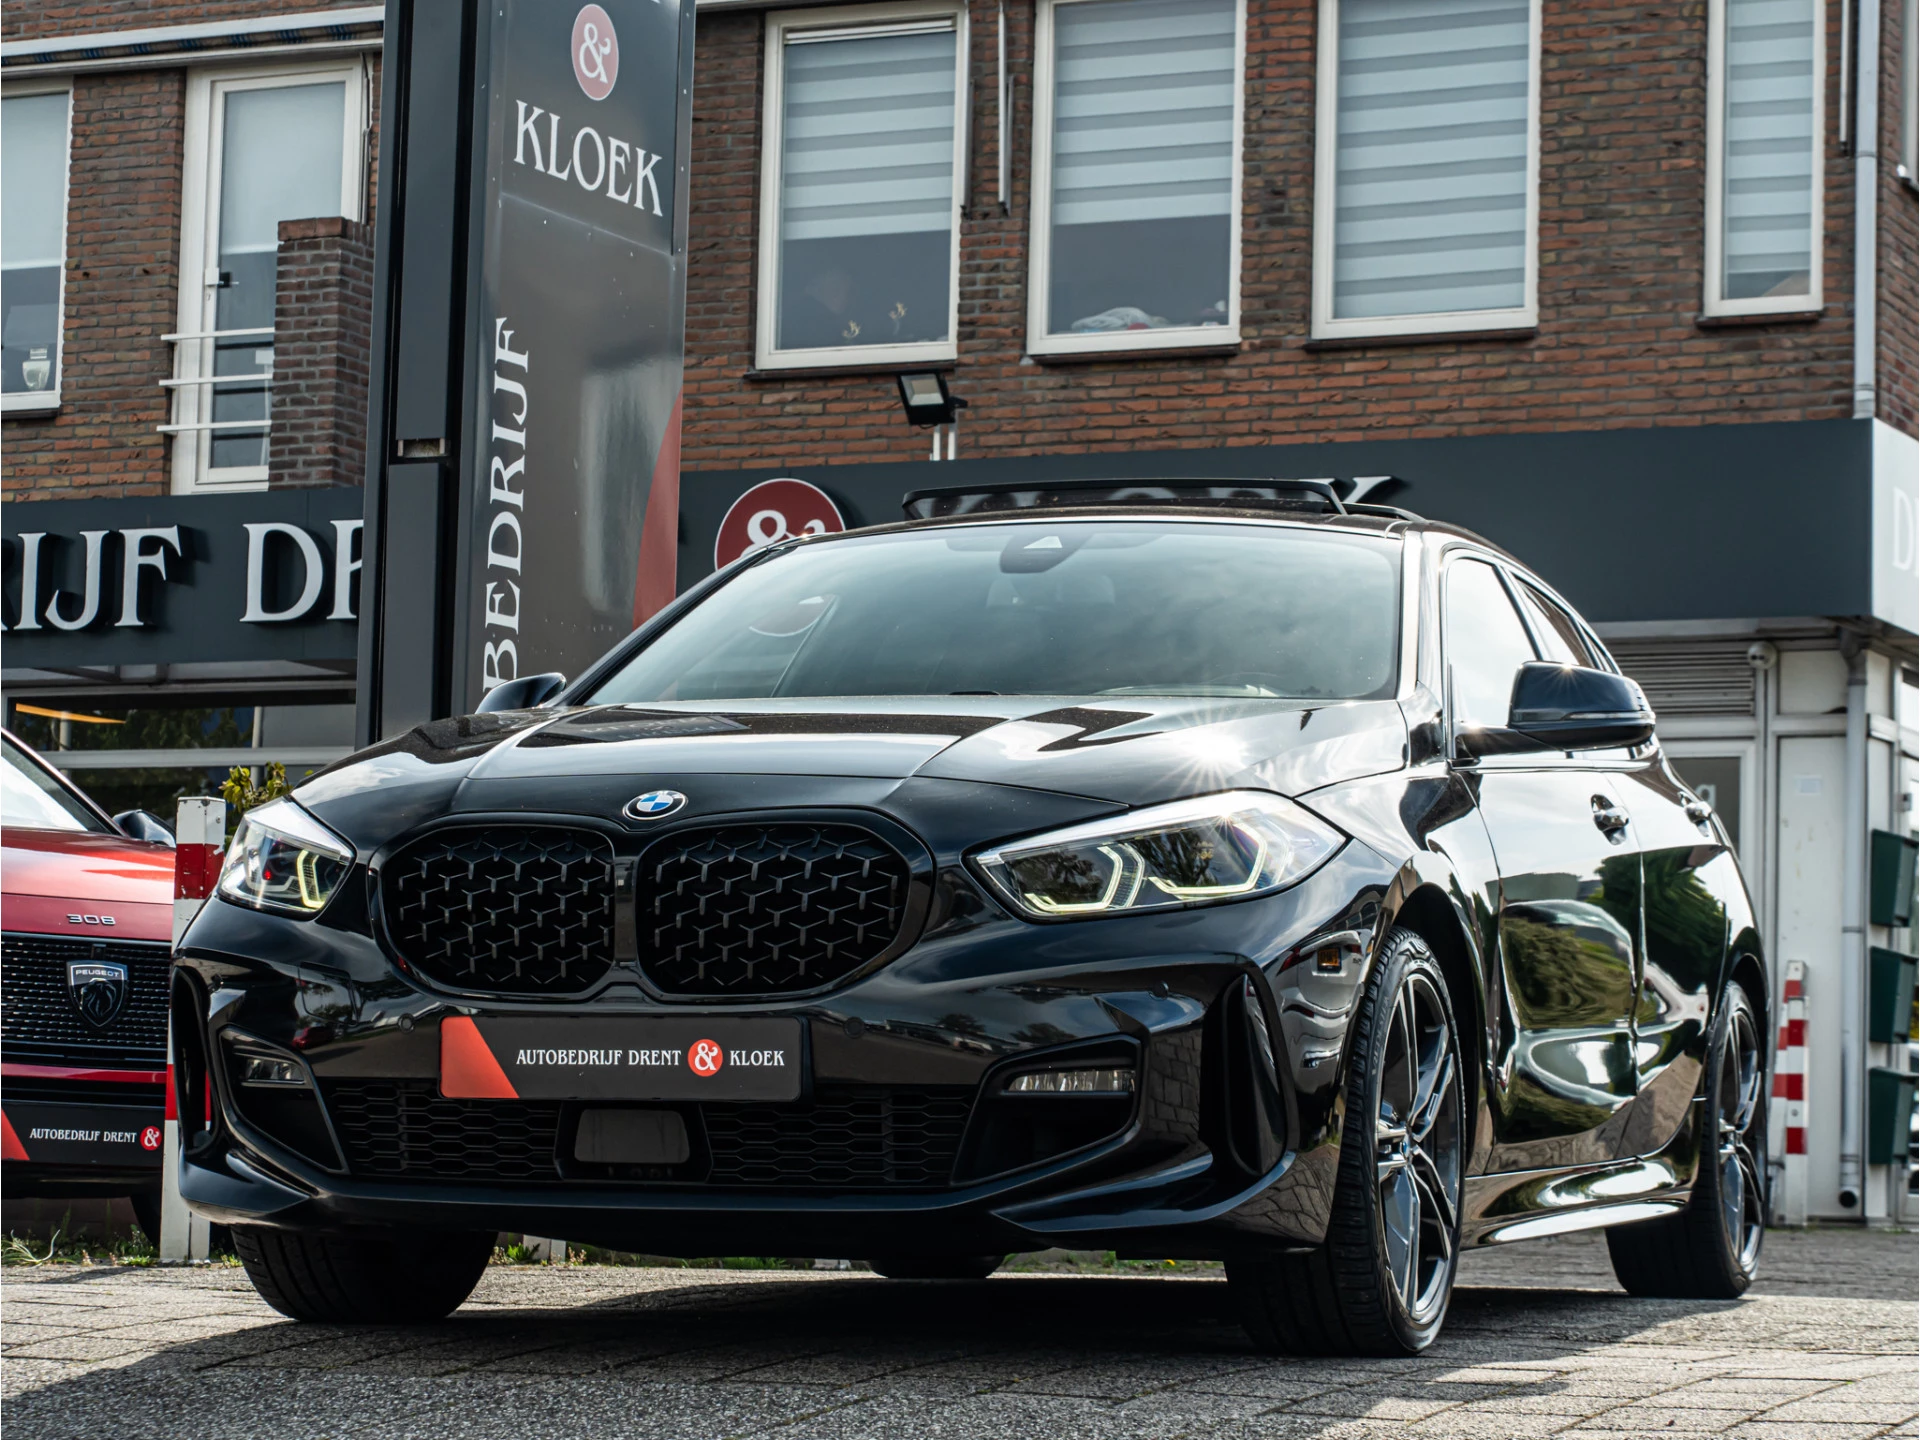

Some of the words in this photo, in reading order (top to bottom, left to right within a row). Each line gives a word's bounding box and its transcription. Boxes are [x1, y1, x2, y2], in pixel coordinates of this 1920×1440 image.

[579, 22, 611, 84] &
[513, 99, 663, 217] KLOEK
[1, 524, 181, 631] IJF
[66, 913, 116, 925] 308
[75, 969, 120, 977] PEUGEOT
[516, 1049, 623, 1065] AUTOBEDRIJF
[628, 1050, 682, 1066] DRENT
[694, 1042, 716, 1071] &
[730, 1050, 785, 1066] KLOEK
[29, 1128, 101, 1142] AUTOBEDRIJF
[103, 1131, 137, 1143] DRENT
[144, 1128, 160, 1147] &
